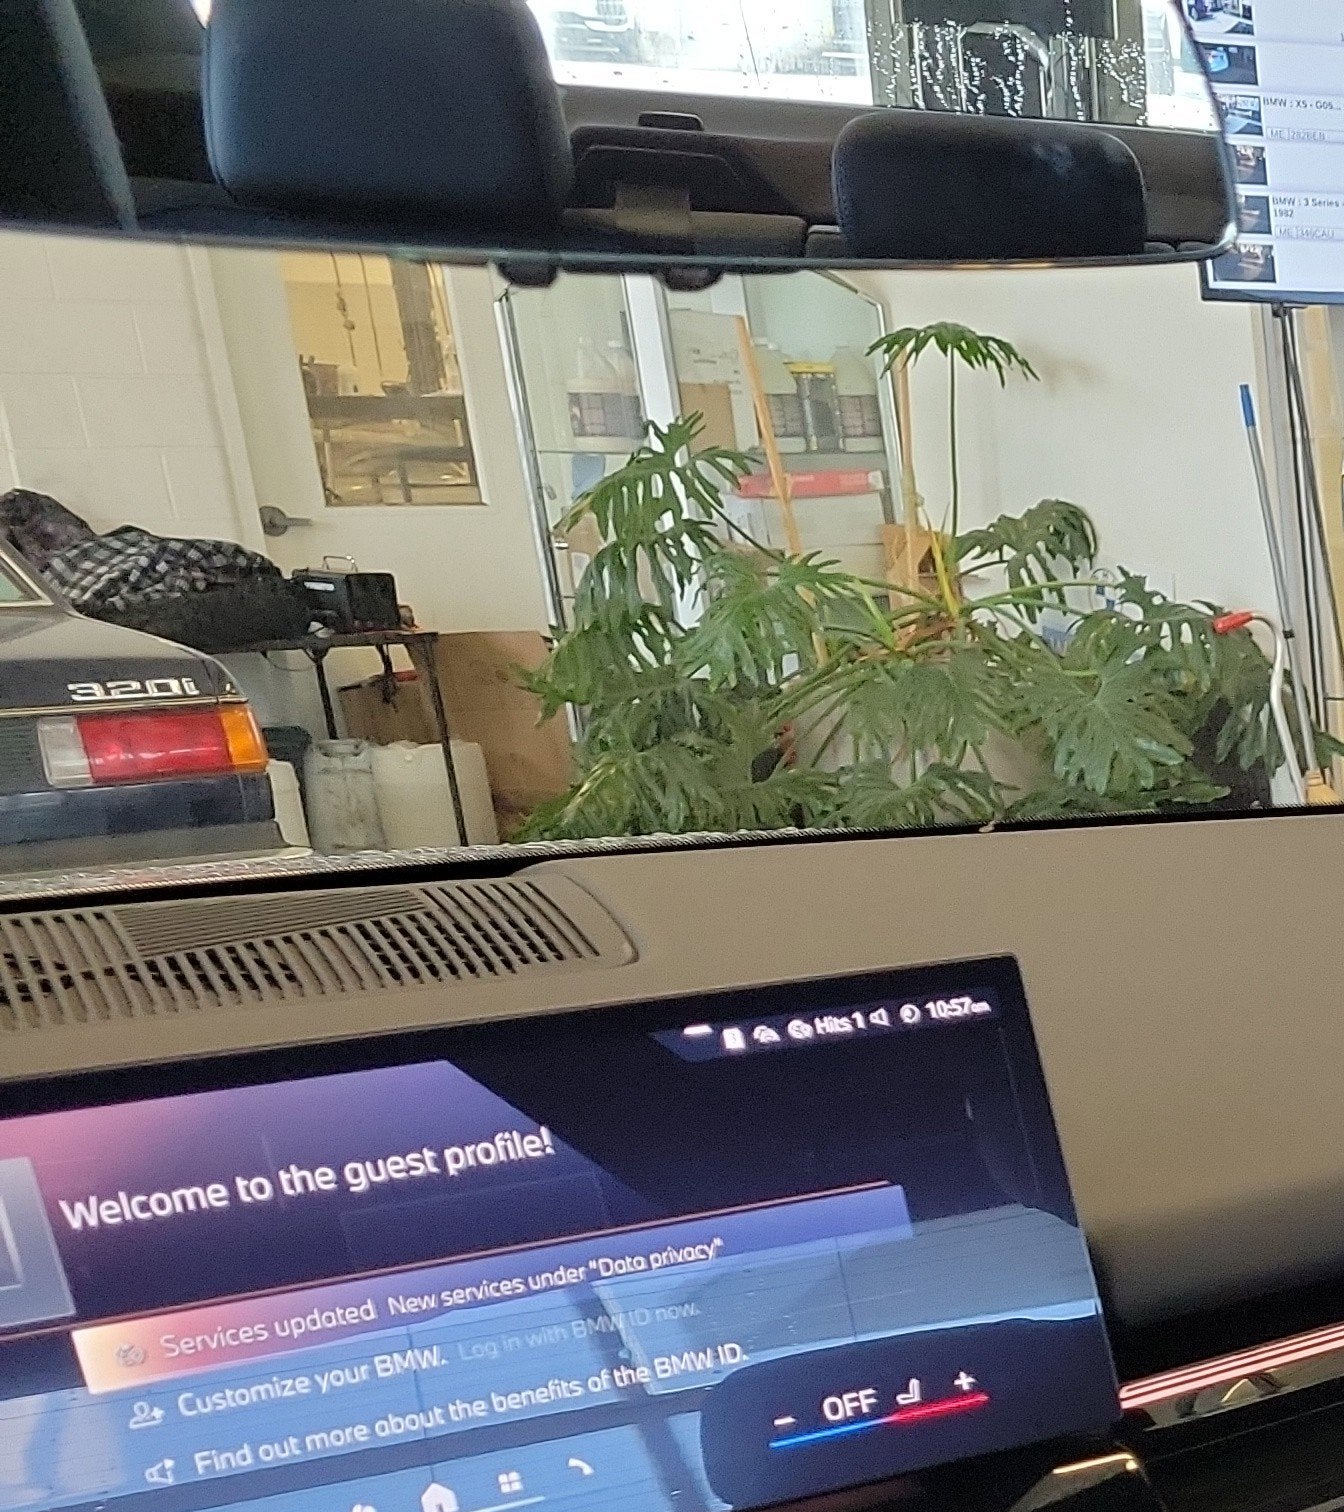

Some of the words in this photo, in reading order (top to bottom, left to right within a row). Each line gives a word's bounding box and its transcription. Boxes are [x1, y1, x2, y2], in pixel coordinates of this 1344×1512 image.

[1263, 97, 1287, 108] BMW
[1295, 100, 1307, 109] X5
[1272, 197, 1296, 207] BMW
[1311, 199, 1340, 209] Series
[67, 678, 200, 701] 320i
[813, 1015, 854, 1035] Hits
[60, 1183, 229, 1231] Welcome
[235, 1172, 273, 1203] to
[280, 1163, 339, 1197] the
[344, 1146, 440, 1194] guest
[444, 1125, 556, 1176] profile!
[160, 1323, 269, 1358] Services
[275, 1299, 377, 1339] updated
[388, 1294, 437, 1316] New
[440, 1274, 525, 1308] services
[528, 1264, 586, 1291] under
[459, 1340, 498, 1362] Log
[502, 1335, 521, 1353] in
[527, 1324, 567, 1347] with
[571, 1313, 625, 1340] BMW
[630, 1307, 650, 1328] ID
[178, 1374, 311, 1417] Customize
[314, 1362, 370, 1395] your
[374, 1345, 450, 1379] BMW.
[194, 1443, 254, 1477] Find
[259, 1434, 301, 1463] out
[305, 1422, 371, 1454] more
[375, 1403, 446, 1438] about
[448, 1396, 487, 1423] the
[490, 1377, 584, 1413] benefits
[587, 1372, 611, 1394] of
[612, 1363, 651, 1387] the
[653, 1349, 712, 1380] BMW
[717, 1341, 750, 1366] ID.
[822, 1386, 877, 1422] OFF
